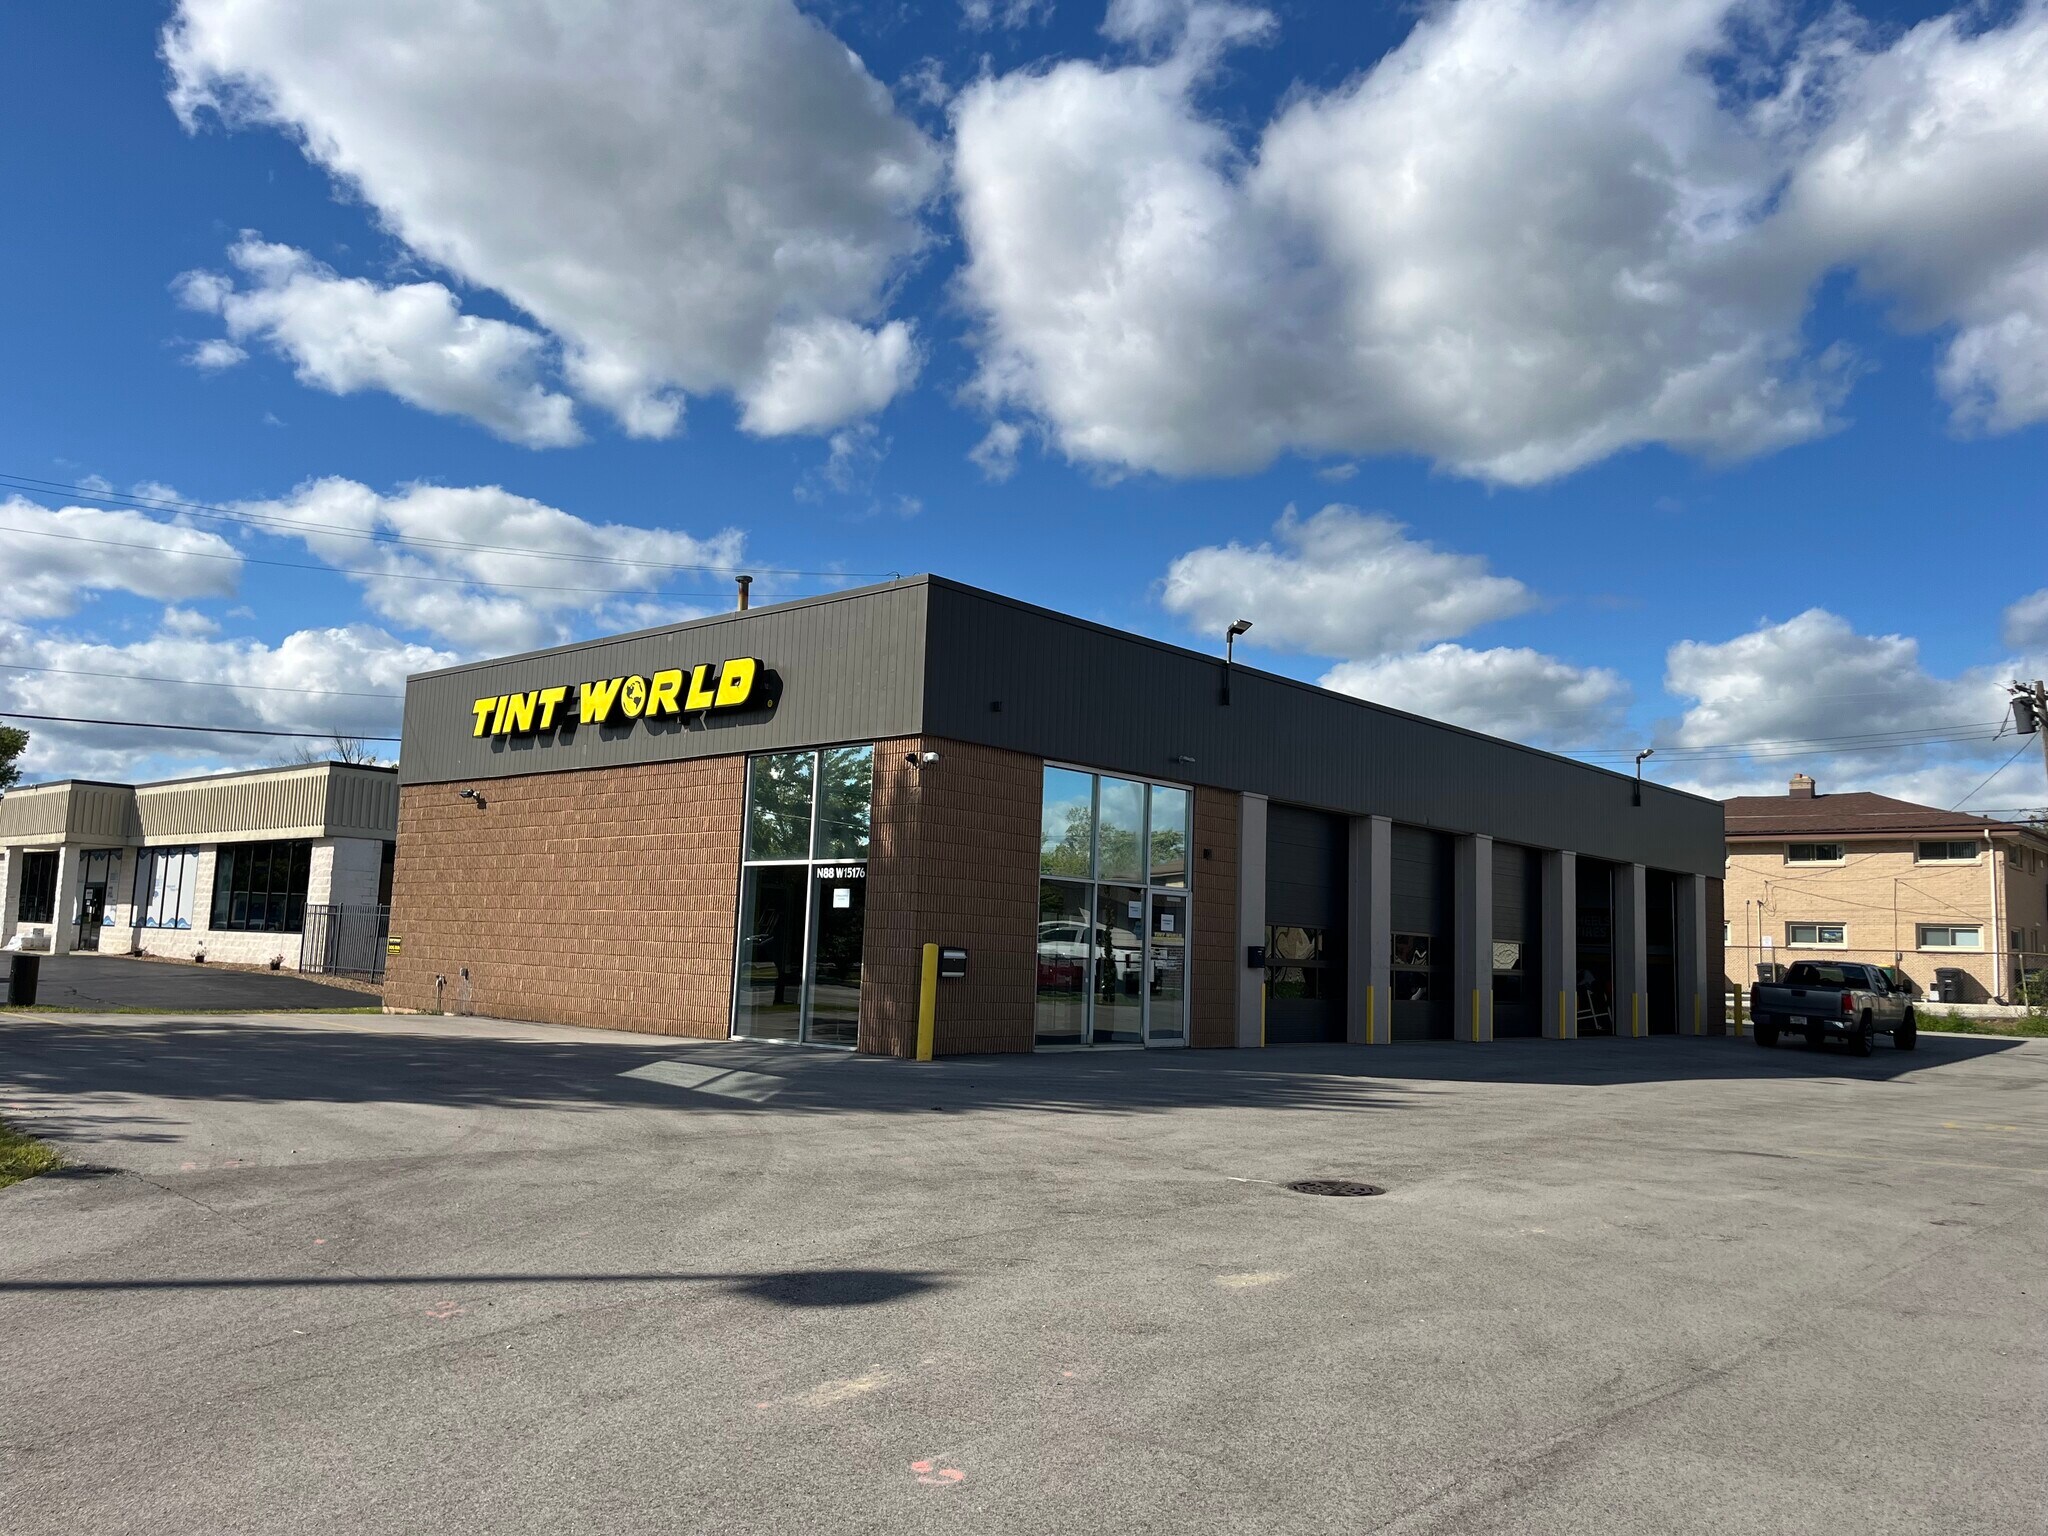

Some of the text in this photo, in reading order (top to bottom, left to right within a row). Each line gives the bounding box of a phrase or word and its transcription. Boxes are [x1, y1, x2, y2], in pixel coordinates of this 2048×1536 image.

[471, 656, 758, 738] TINT WORLD
[816, 867, 866, 879] N88 W15176
